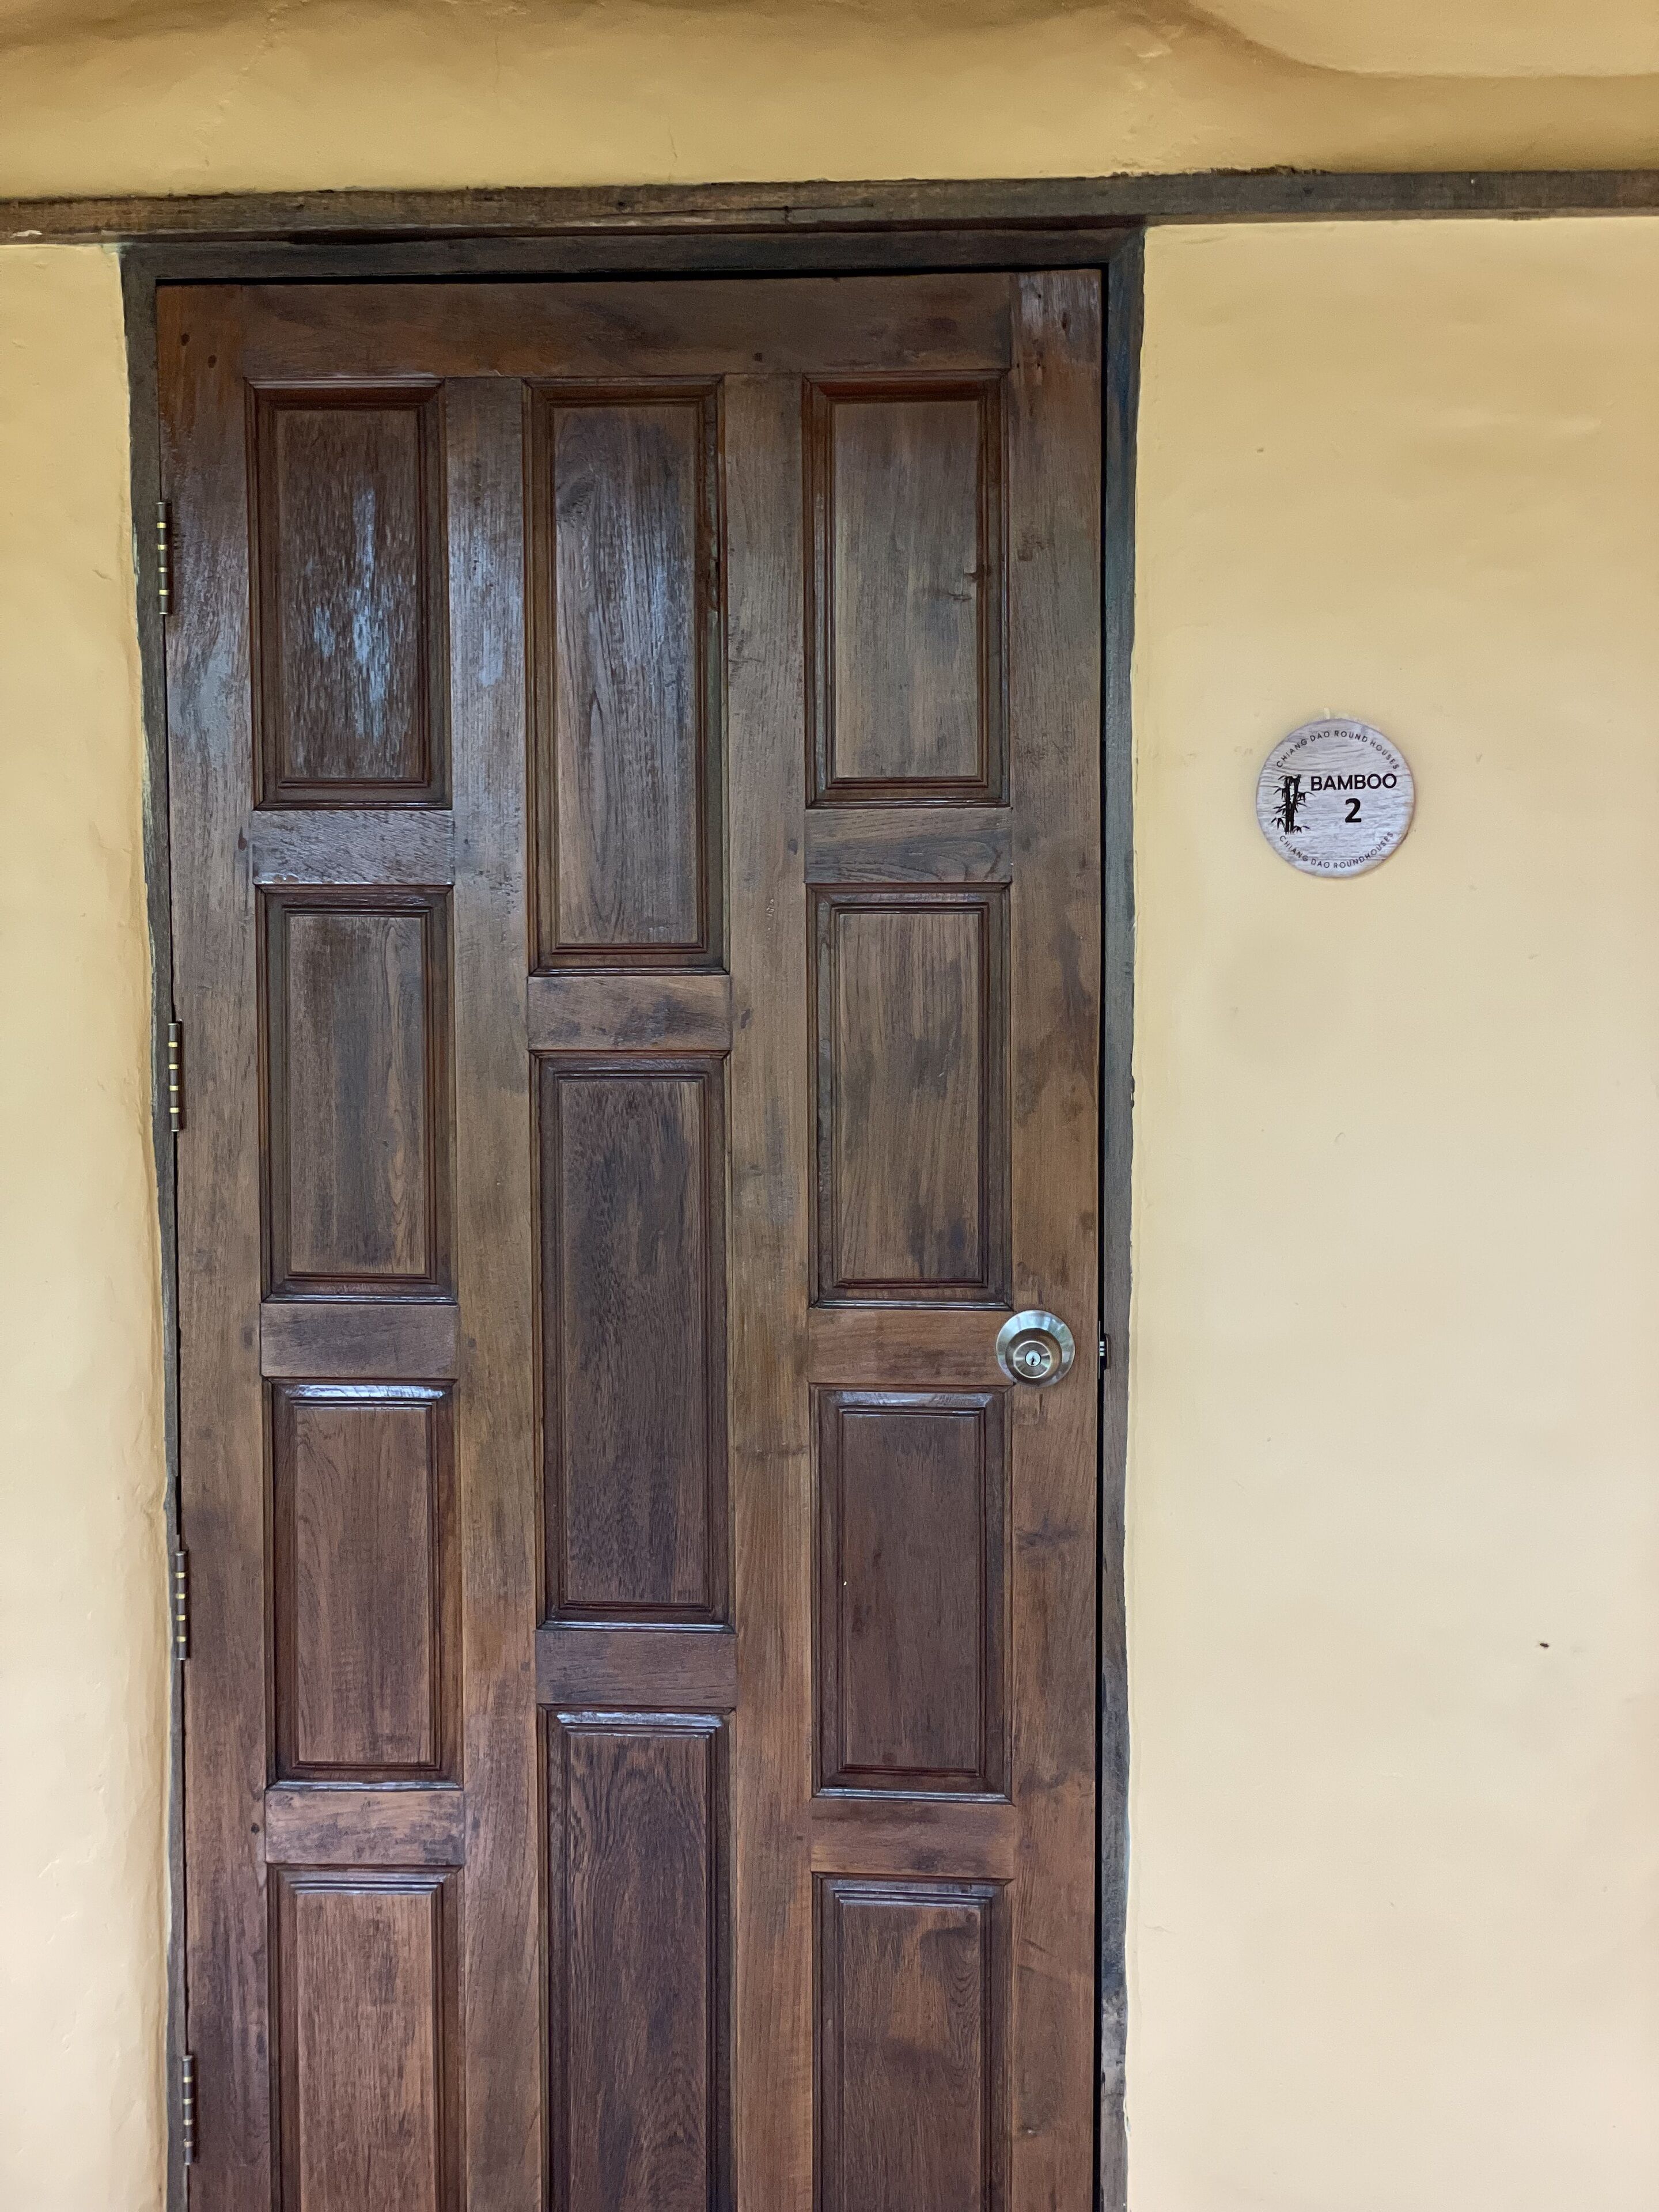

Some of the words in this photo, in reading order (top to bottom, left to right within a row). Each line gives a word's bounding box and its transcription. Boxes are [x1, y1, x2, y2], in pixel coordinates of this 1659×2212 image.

[1277, 738, 1308, 768] CHIANG
[1309, 730, 1330, 742] DAO
[1334, 730, 1368, 743] ROUND
[1370, 740, 1400, 770] HOUSES
[1310, 773, 1397, 791] BAMBOO
[1344, 798, 1362, 823] 2
[1279, 835, 1308, 862] CHIANG
[1310, 858, 1330, 869] DAO
